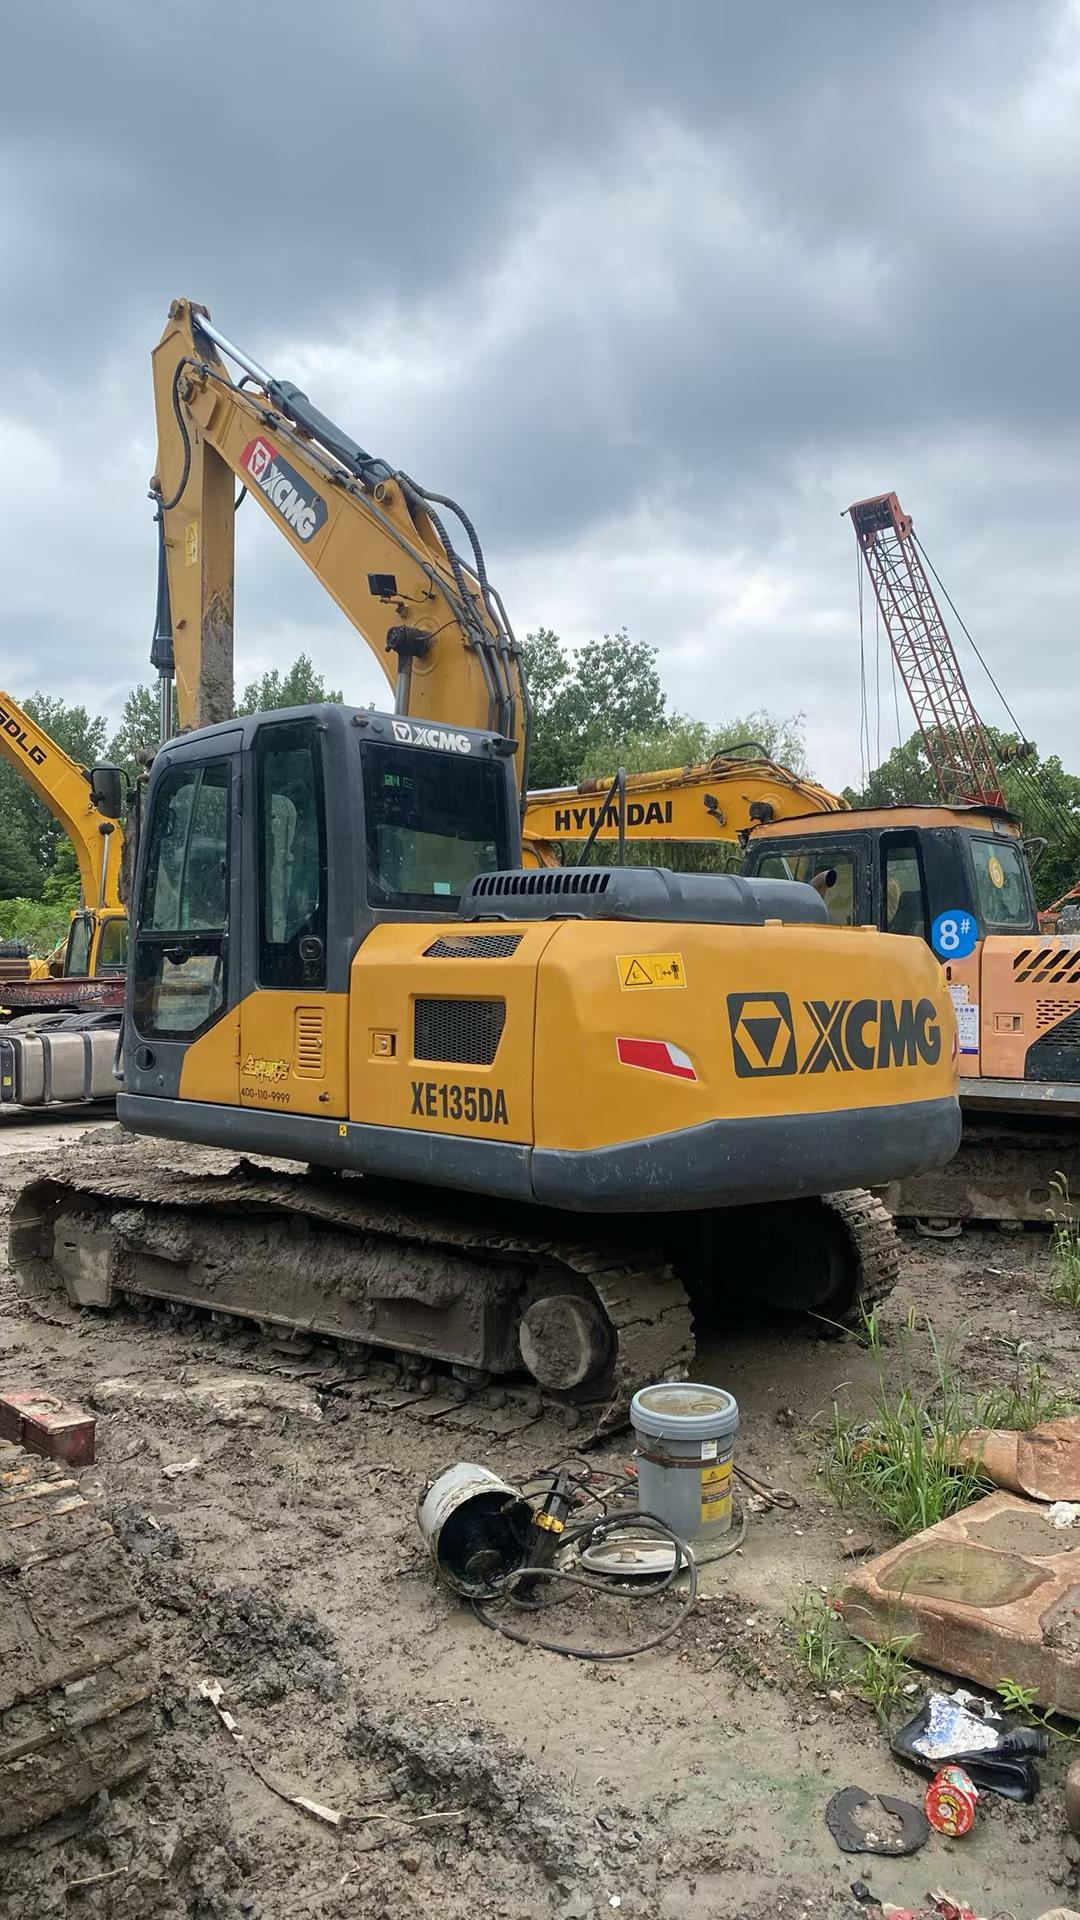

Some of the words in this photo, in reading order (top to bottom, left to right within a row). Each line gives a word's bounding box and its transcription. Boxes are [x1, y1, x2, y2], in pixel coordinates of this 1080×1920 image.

[260, 462, 317, 539] XCMG
[413, 726, 472, 753] XCMG
[799, 998, 941, 1074] XCMG
[240, 1087, 290, 1103] 400-110-9999
[411, 1081, 509, 1125] XE135DA
